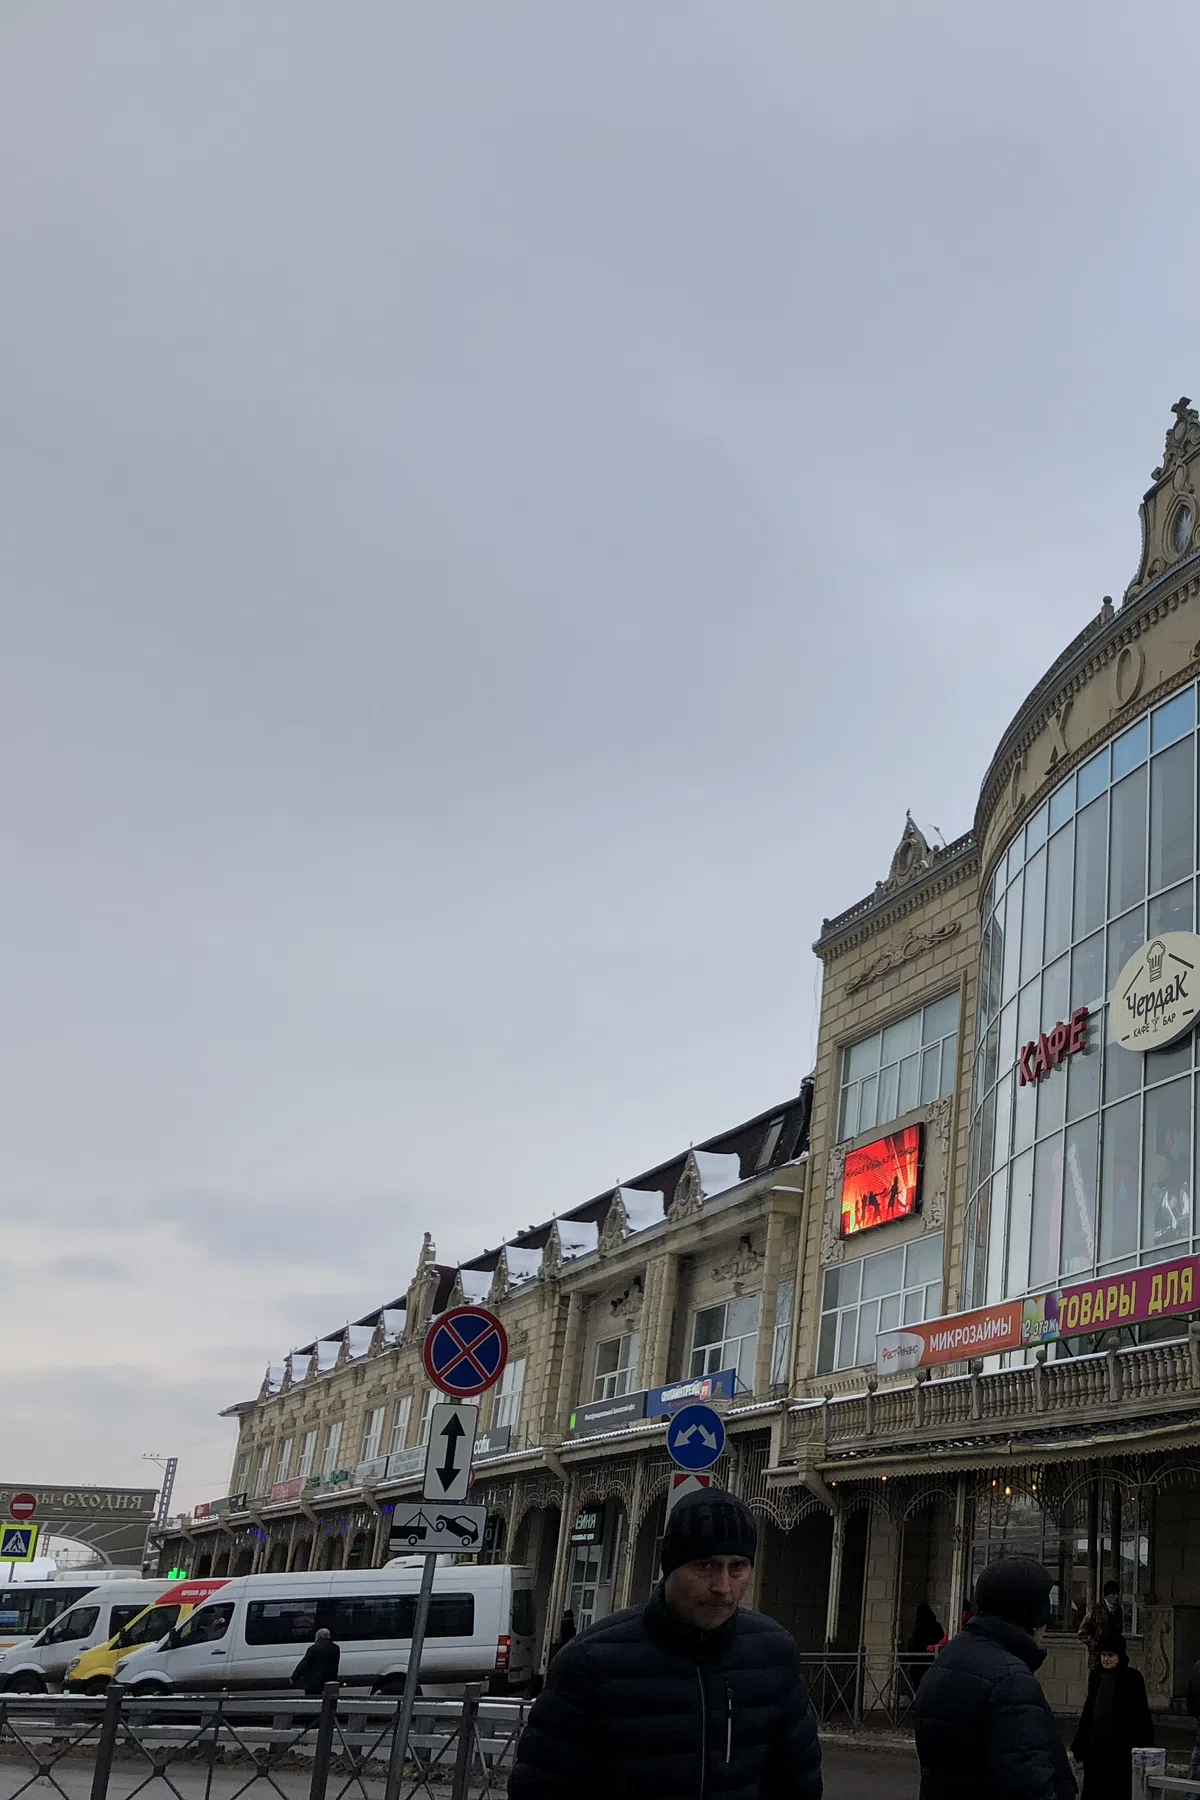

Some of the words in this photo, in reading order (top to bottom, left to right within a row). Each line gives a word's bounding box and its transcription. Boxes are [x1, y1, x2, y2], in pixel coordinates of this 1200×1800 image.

[1133, 1023, 1150, 1038] КАФЕ
[1162, 1013, 1176, 1026] БАР
[1019, 1007, 1089, 1086] КАФЕ
[1058, 1281, 1137, 1330] ТОВАРЫ
[1148, 1267, 1192, 1315] ДЛЯ
[929, 1315, 1012, 1352] МИКРОЗАЙМЫ
[1023, 1318, 1031, 1338] 2
[1032, 1318, 1058, 1334] этаж
[62, 1492, 143, 1510] СХОДНЯ
